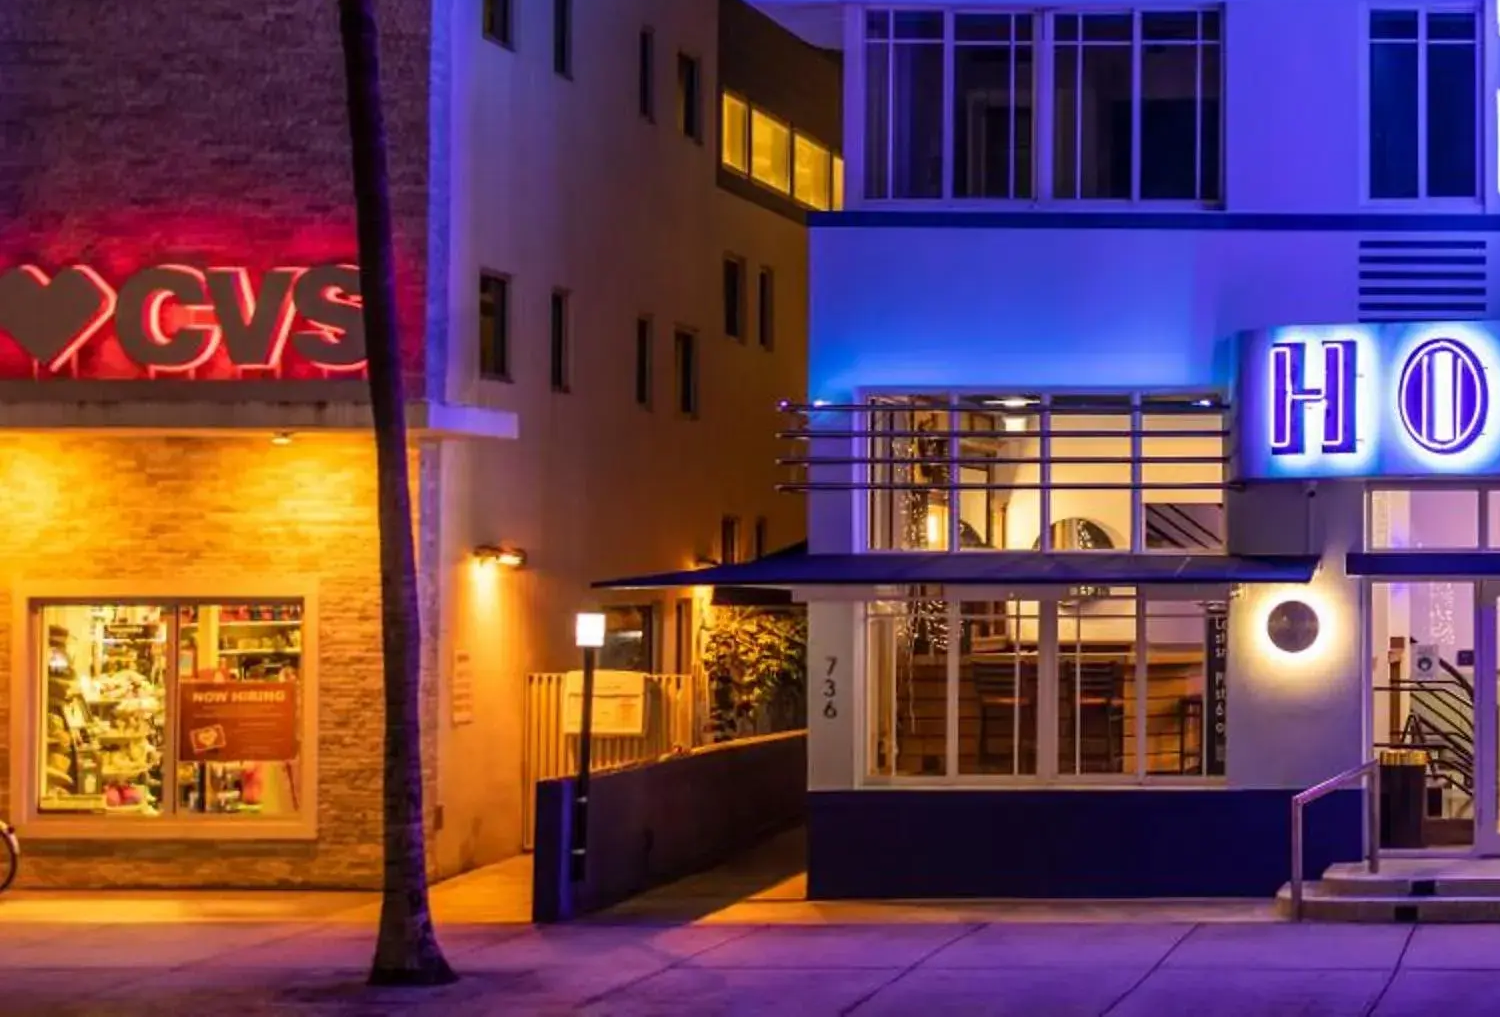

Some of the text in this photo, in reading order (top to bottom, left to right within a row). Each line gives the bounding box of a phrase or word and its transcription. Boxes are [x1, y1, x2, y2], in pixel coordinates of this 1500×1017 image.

[114, 263, 369, 371] CVS
[193, 690, 285, 702] NOW HIRING
[823, 656, 837, 719] 736
